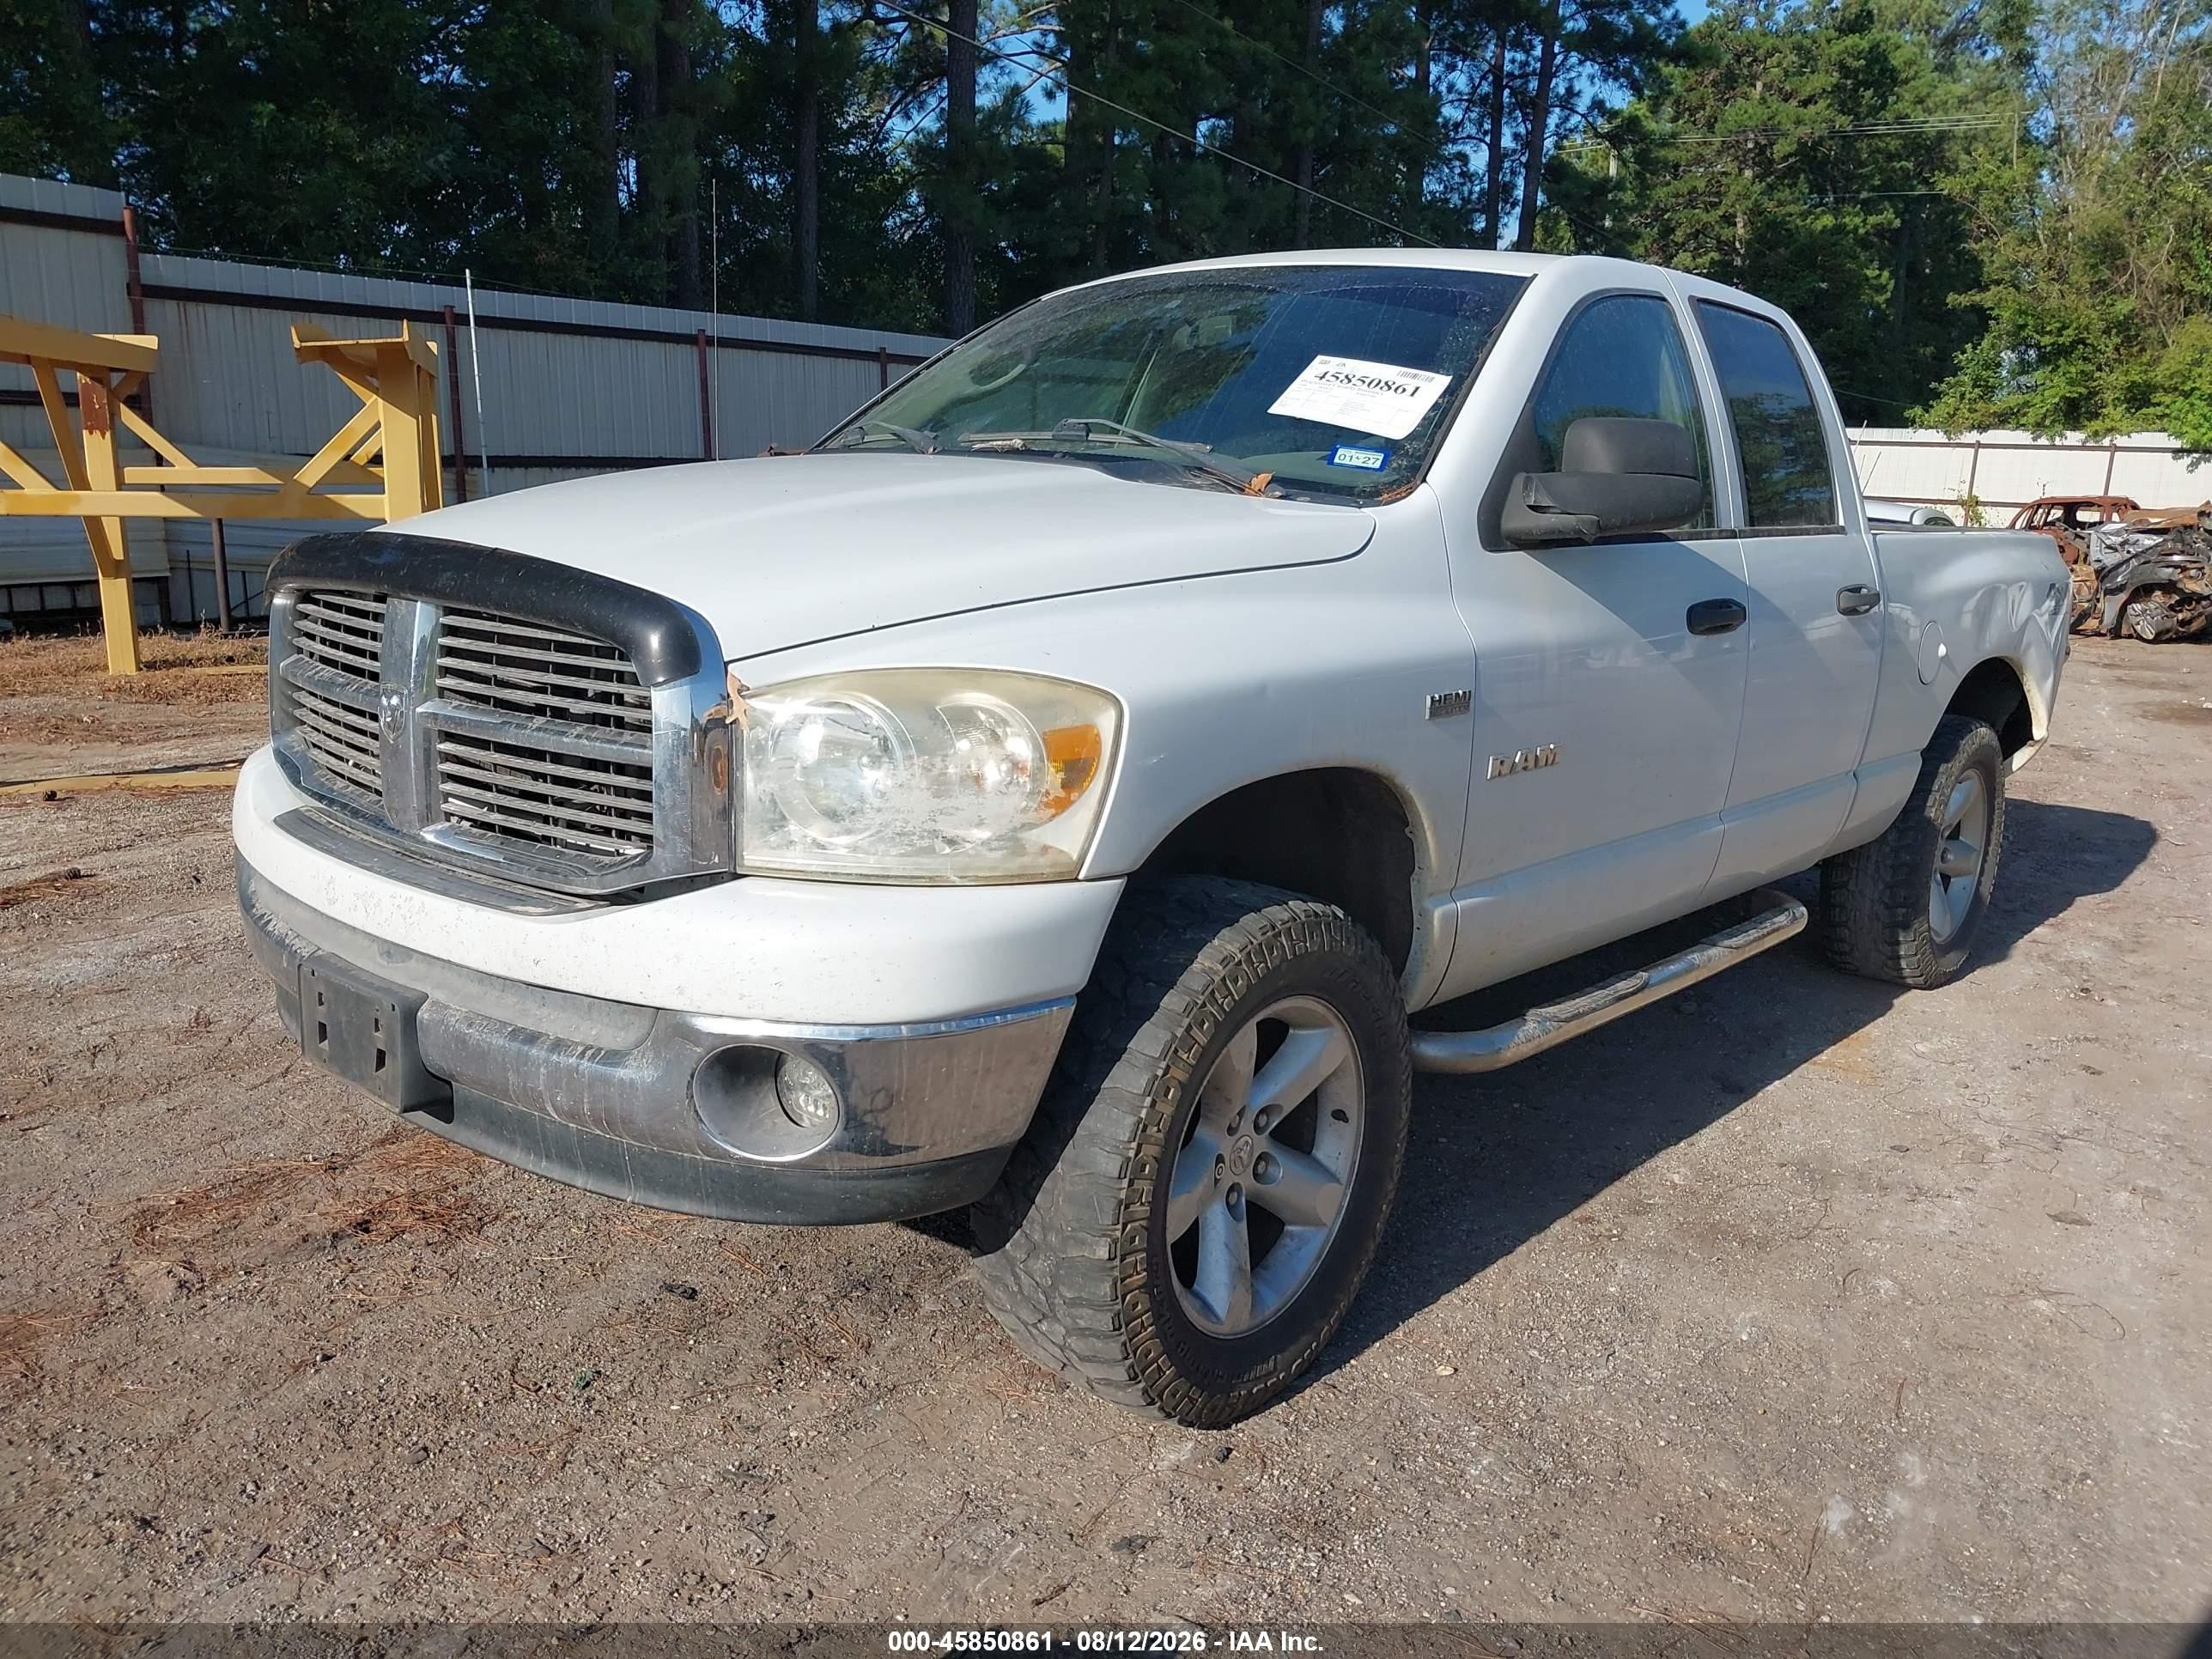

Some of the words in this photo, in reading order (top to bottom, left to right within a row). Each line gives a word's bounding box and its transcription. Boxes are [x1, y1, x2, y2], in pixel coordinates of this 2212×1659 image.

[1314, 370, 1421, 398] 45850861
[1426, 690, 1472, 708] HEMI
[1486, 743, 1562, 780] RAM
